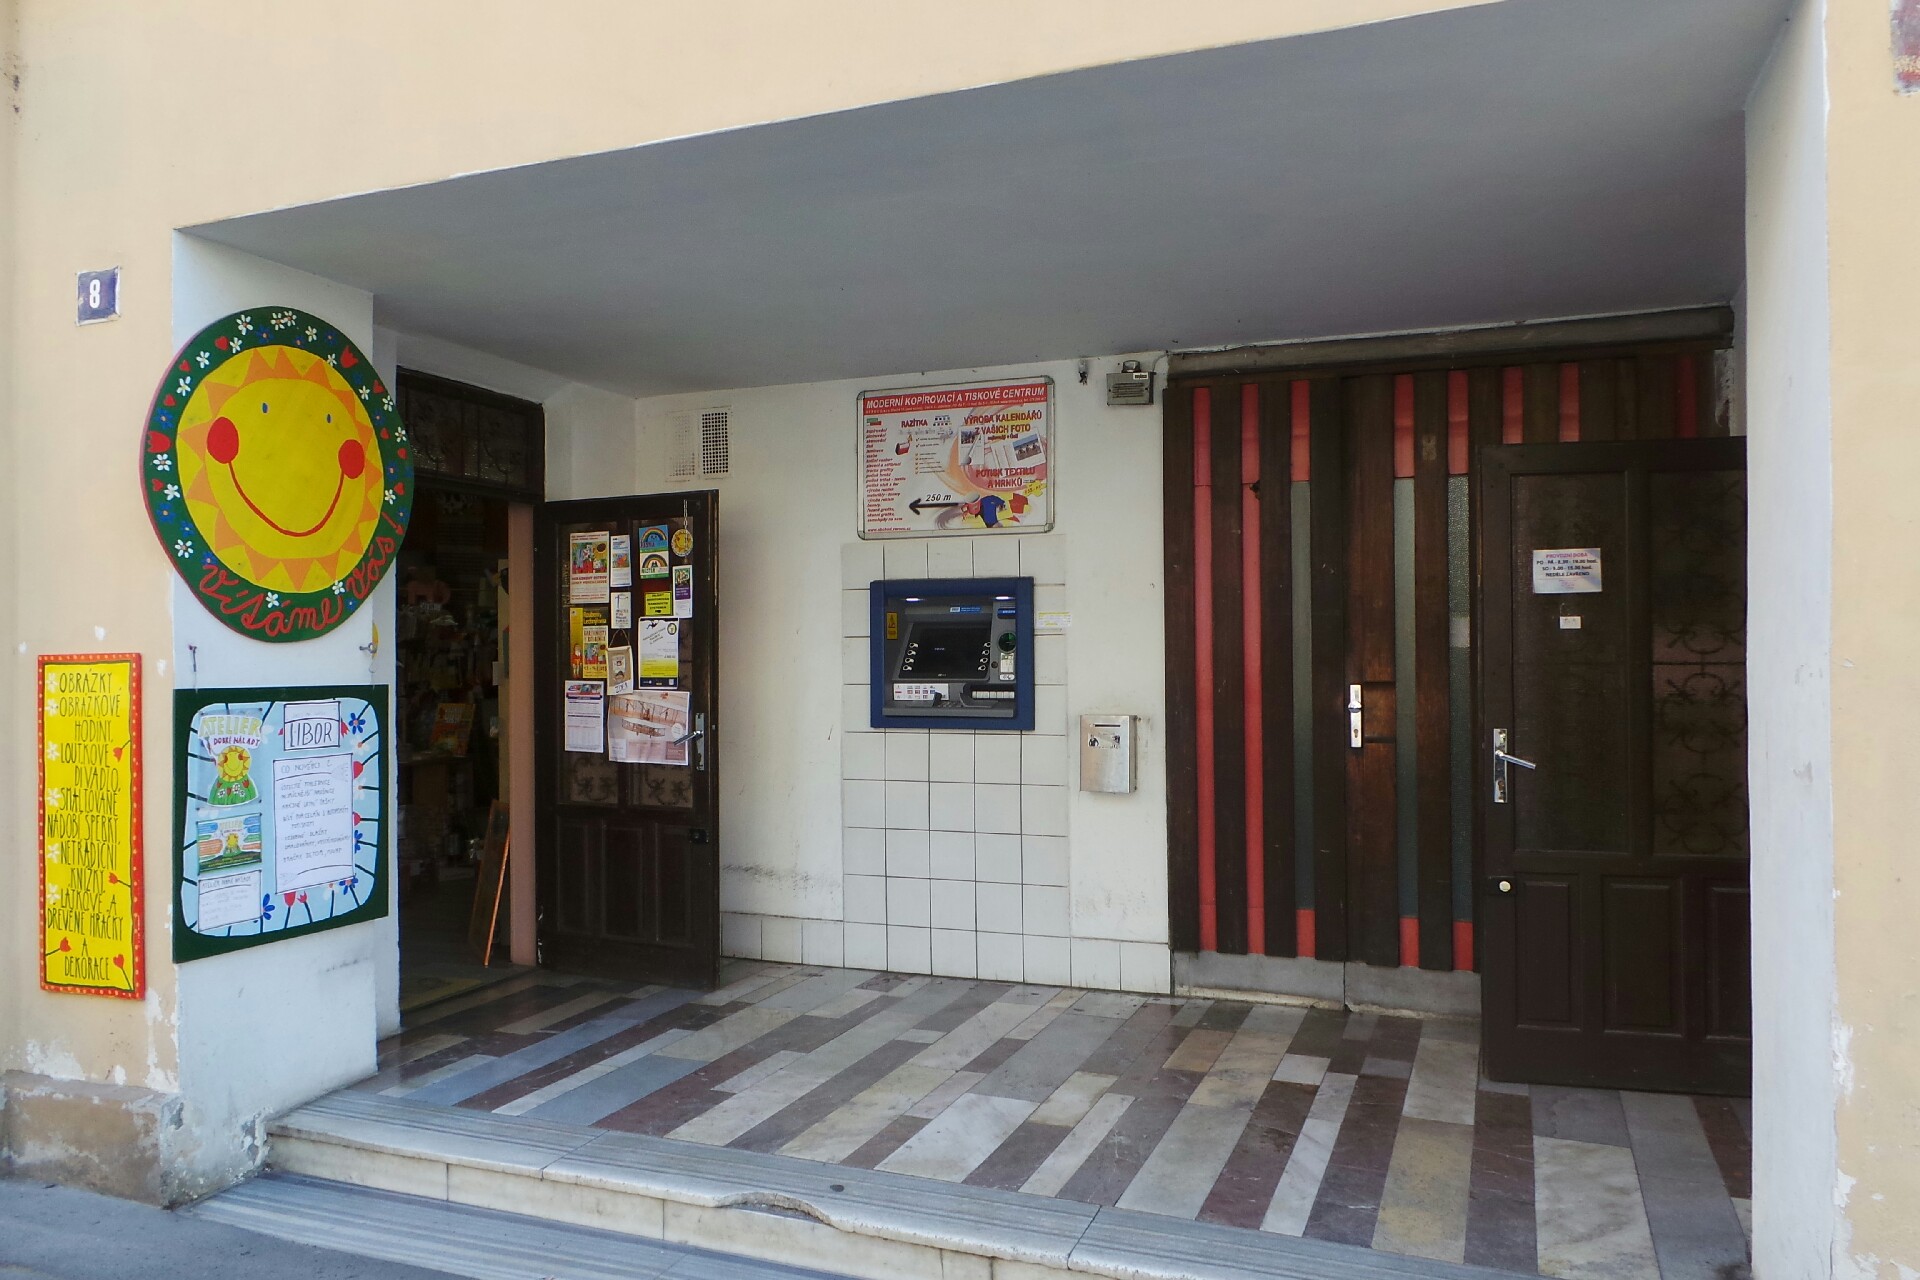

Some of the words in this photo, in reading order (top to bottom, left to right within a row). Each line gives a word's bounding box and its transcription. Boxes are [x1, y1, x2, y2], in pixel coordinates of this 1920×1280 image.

[90, 279, 100, 308] 8
[866, 396, 904, 408] MODERNÍ
[904, 391, 956, 406] KOPÍROVACÍ
[956, 393, 963, 401] A
[965, 387, 1001, 401] TISKOVÉ
[1002, 386, 1045, 399] CENTRUM
[901, 418, 928, 429] RAZÍTKA
[981, 424, 1009, 434] VAŠICH
[1010, 423, 1031, 433] FOTO
[976, 468, 1003, 478] POTISK
[1004, 467, 1036, 477] TEXTILU
[925, 494, 942, 502] 250
[59, 668, 112, 693] OBRÁZKY
[290, 721, 332, 747] LIBOR
[81, 937, 89, 957] A
[64, 955, 110, 981] DEKORACE
